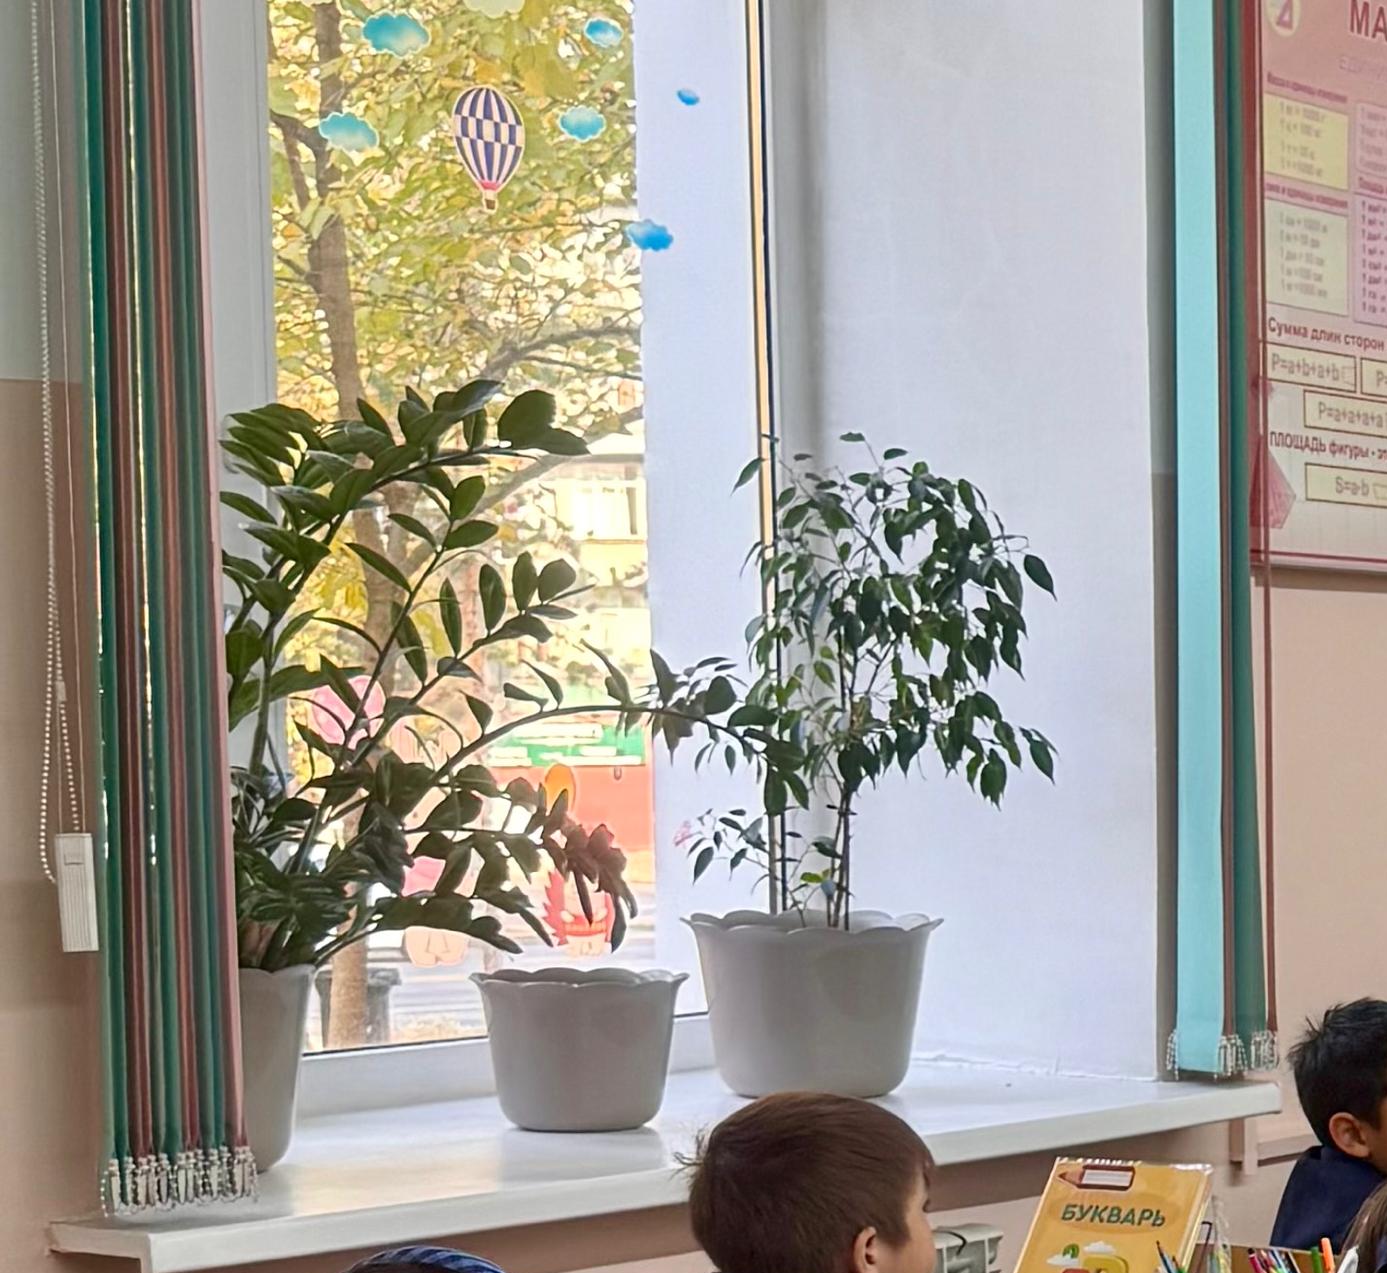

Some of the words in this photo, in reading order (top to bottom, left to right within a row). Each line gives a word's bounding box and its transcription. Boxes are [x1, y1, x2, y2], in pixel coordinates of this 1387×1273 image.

[1268, 316, 1308, 339] Сумма
[1311, 327, 1342, 344] длин
[1344, 335, 1384, 352] сторон
[1269, 431, 1327, 453] ПЛОЩАДЬ
[1060, 1202, 1167, 1228] БУКВАРЬ
